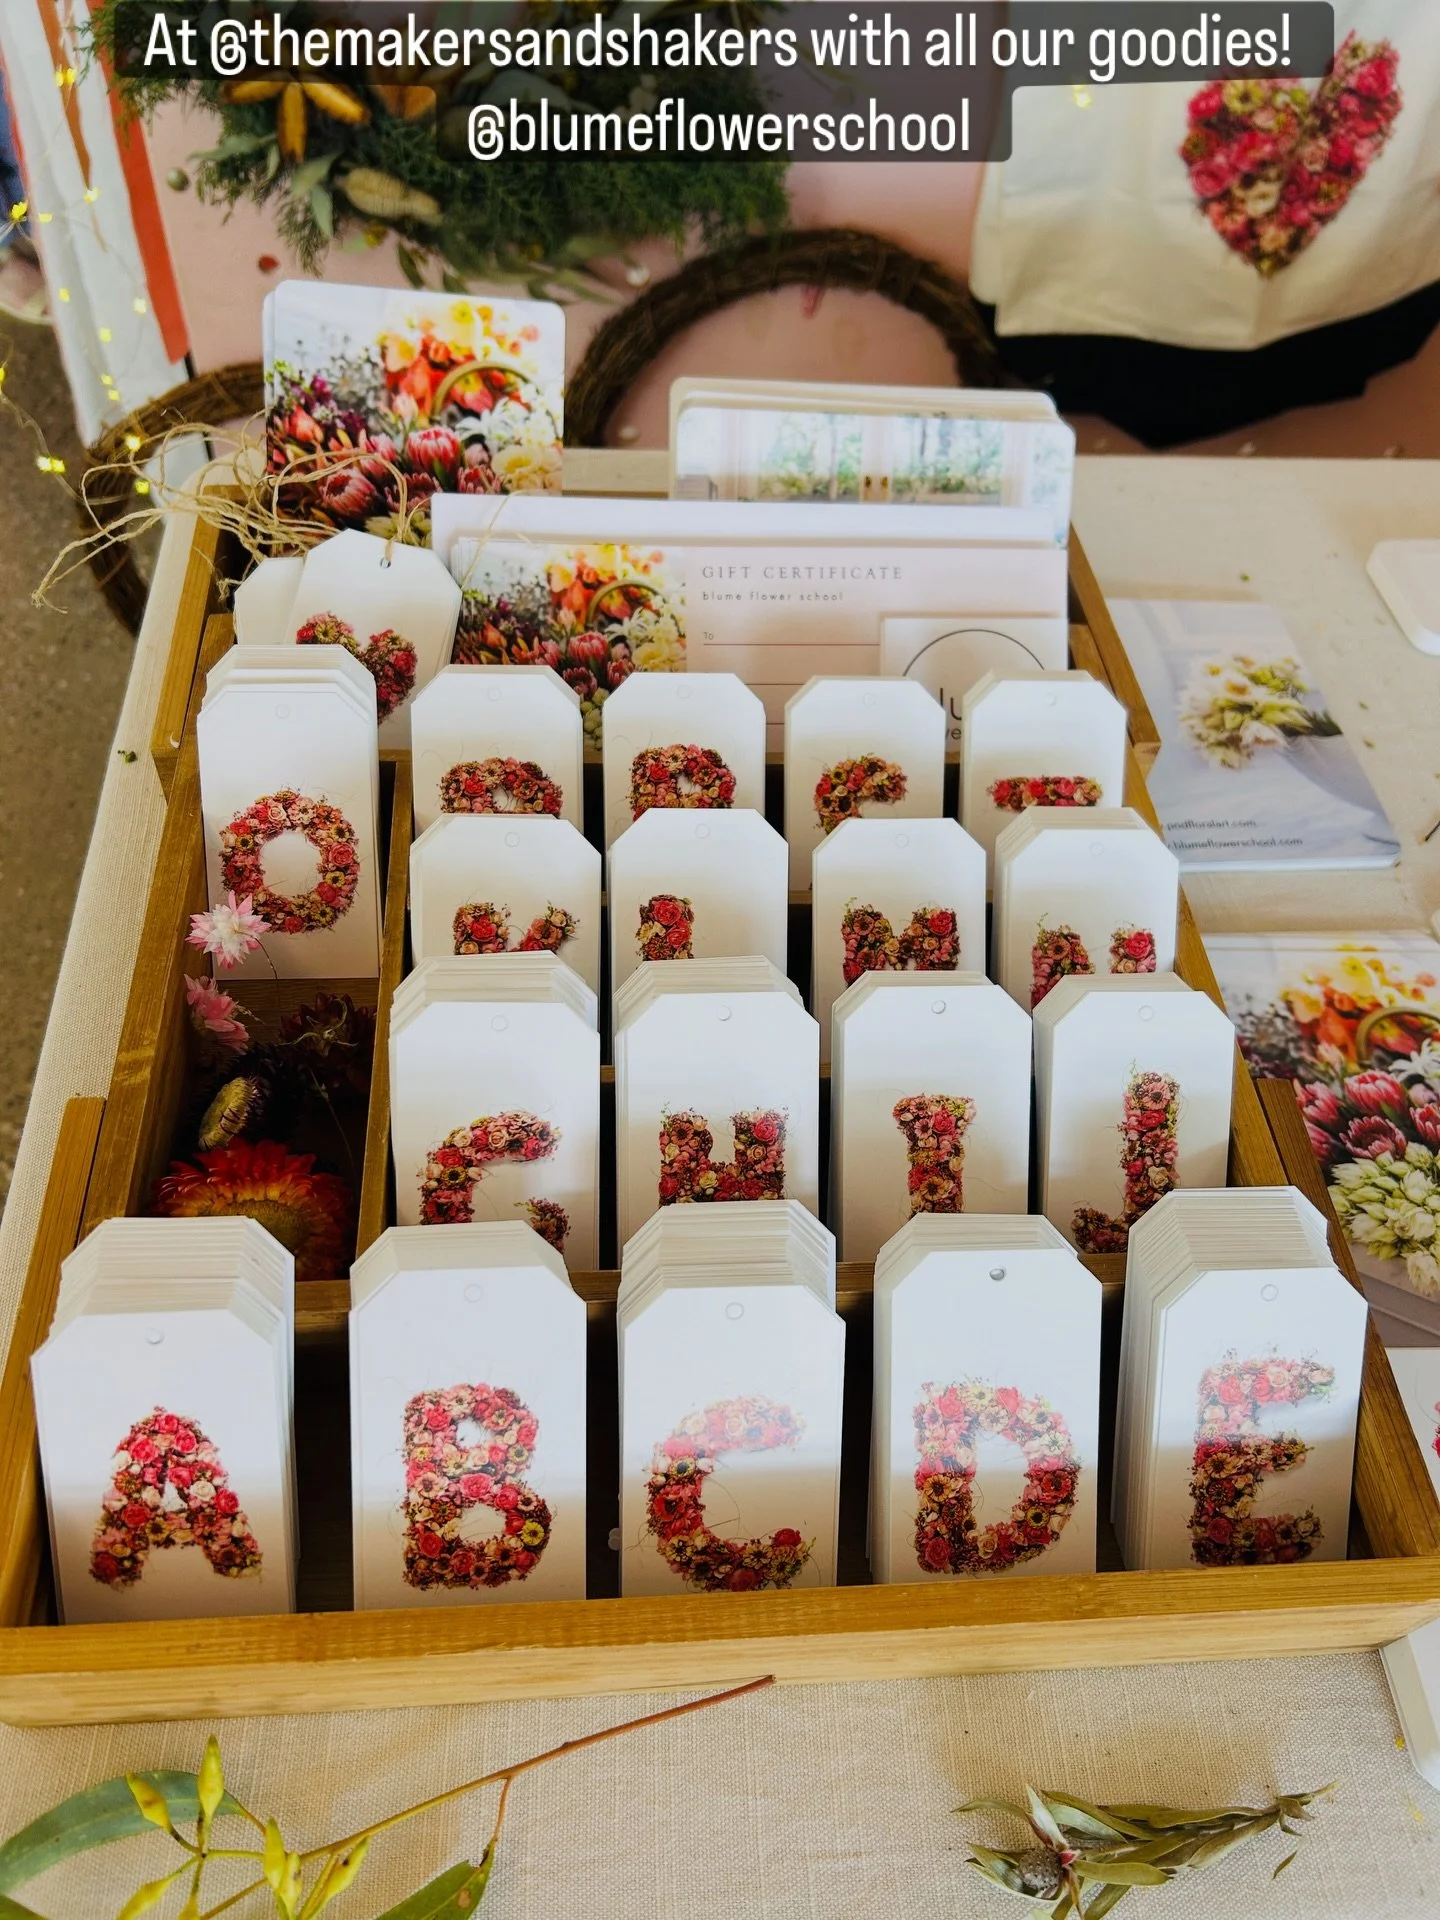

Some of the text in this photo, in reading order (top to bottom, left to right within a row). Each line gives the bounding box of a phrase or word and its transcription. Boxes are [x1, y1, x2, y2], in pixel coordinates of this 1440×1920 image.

[702, 566, 903, 580] GIFT CERTIFICATE
[702, 591, 843, 601] blume flower school
[91, 1405, 262, 1591] A
[402, 1383, 555, 1589] B
[644, 1396, 815, 1592] C
[912, 1380, 1082, 1576] D
[1190, 1354, 1336, 1566] E
